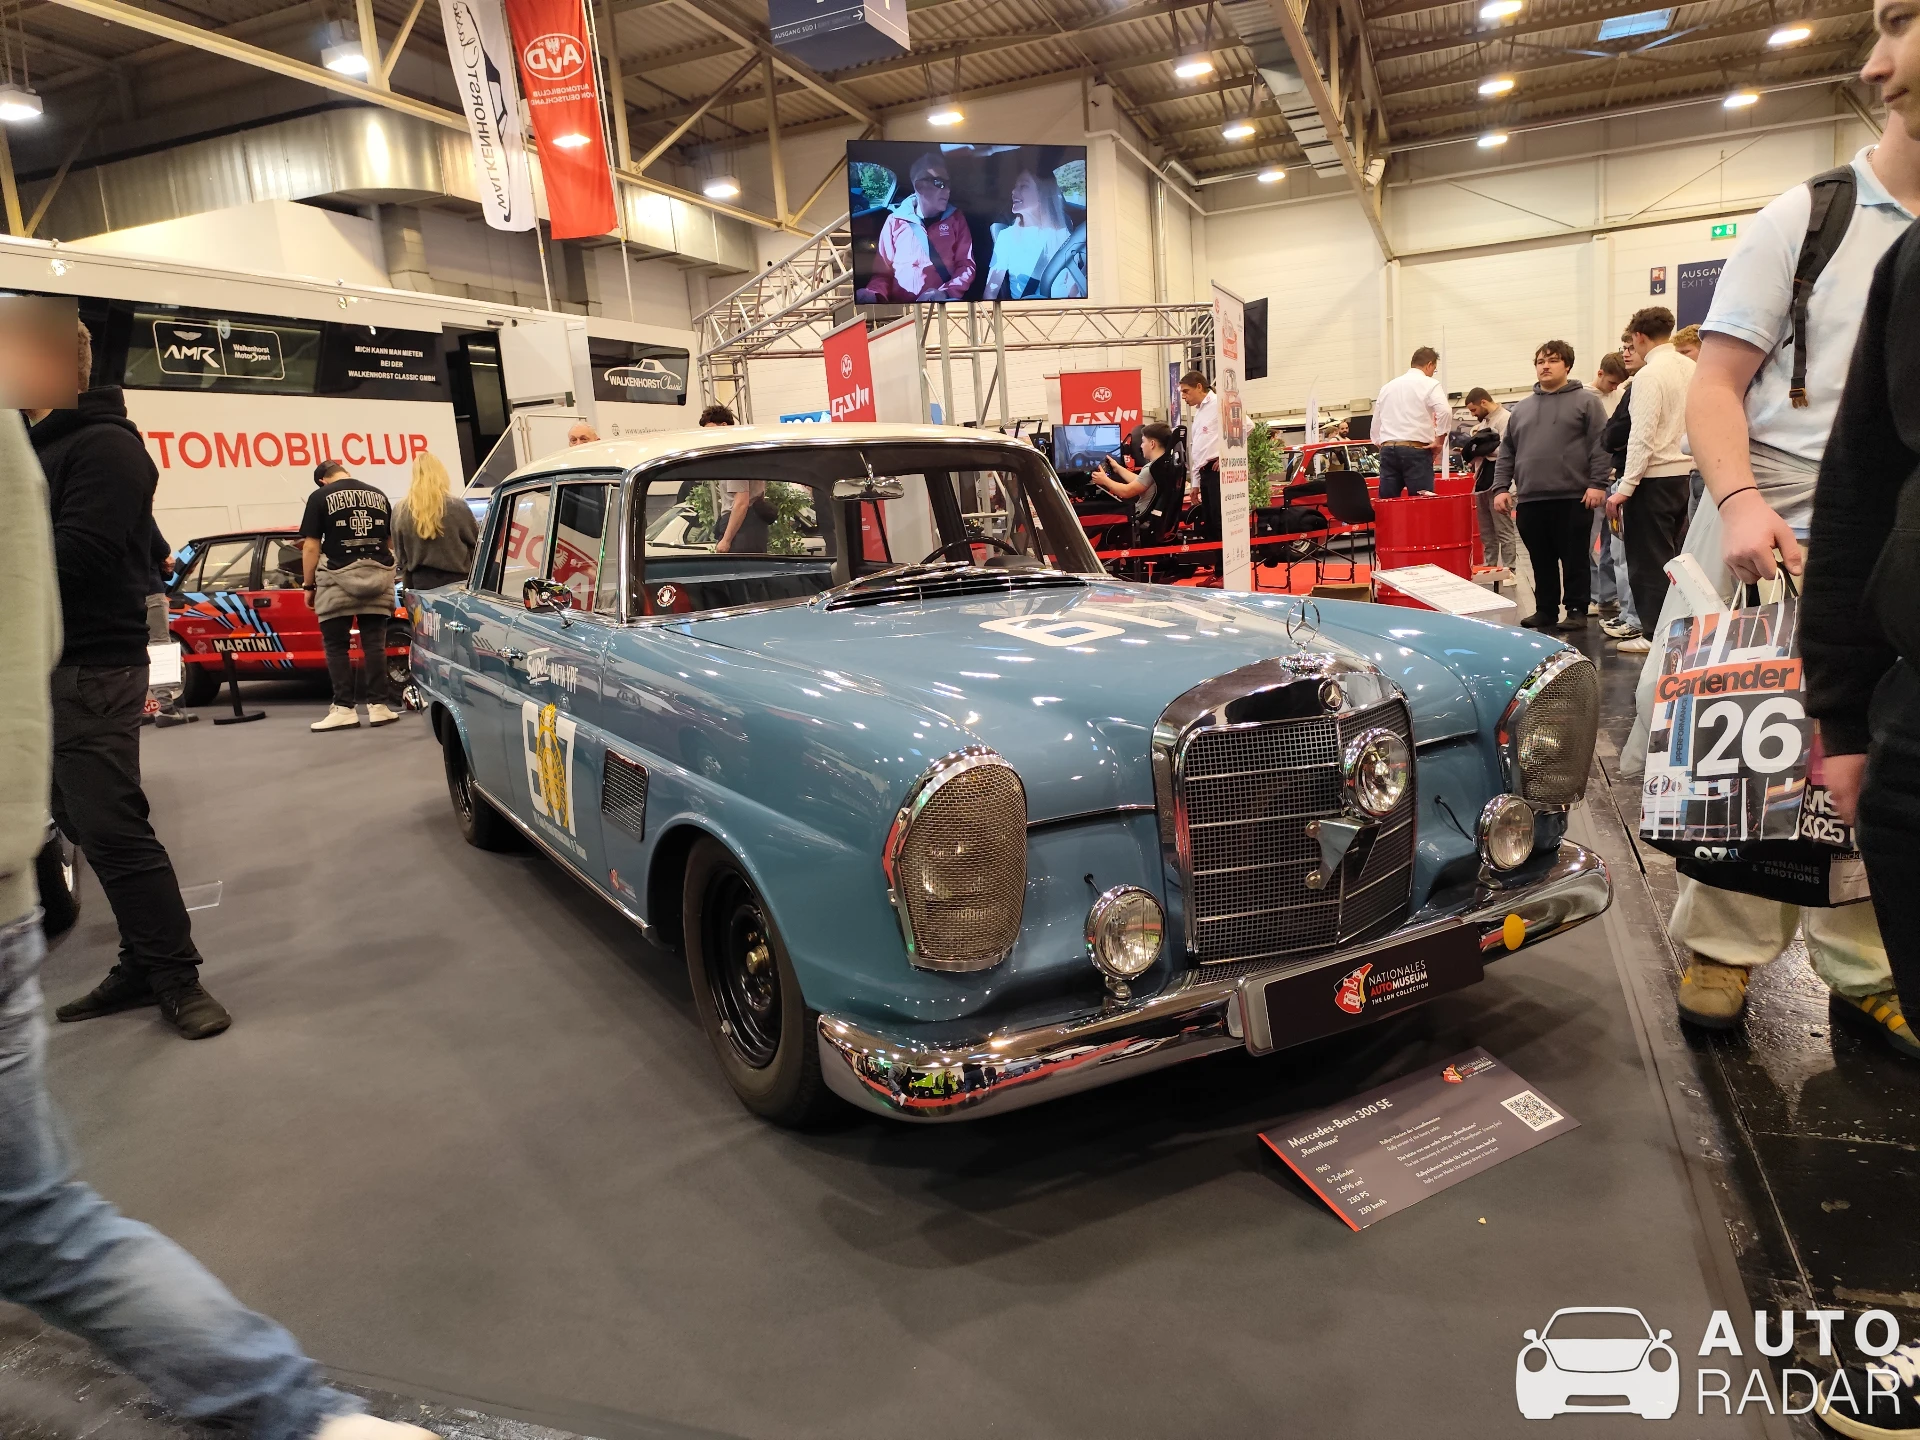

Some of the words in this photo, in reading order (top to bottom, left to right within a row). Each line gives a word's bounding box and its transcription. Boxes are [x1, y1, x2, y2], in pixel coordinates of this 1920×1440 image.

[774, 29, 800, 39] AUSGANG
[802, 24, 814, 33] SÜD
[1682, 279, 1704, 289] EXIT
[164, 344, 220, 368] AMR
[232, 343, 270, 354] Walkenhorst
[371, 347, 388, 355] KANN
[389, 348, 402, 356] MAN
[402, 349, 423, 358] MIETEN
[348, 370, 394, 379] WALKENHORST
[394, 373, 419, 381] CLASSIC
[609, 375, 660, 389] WALKENHORST
[660, 375, 682, 390] Classic
[140, 431, 429, 468] TOMOBILCLUB
[326, 490, 356, 515] NEW
[213, 638, 273, 652] MARTINI
[1676, 697, 1688, 764] JPPERFORMANCE
[1696, 696, 1806, 777] 26
[1764, 866, 1820, 885] EMOTIONS
[1369, 960, 1426, 986] NATIONALES
[1371, 970, 1428, 997] AUTOMUSEUM
[1384, 993, 1395, 1001] LOH
[1396, 982, 1429, 997] COLLECTION
[1457, 1057, 1488, 1071] NATIONALES
[1288, 1115, 1359, 1148] Mercedes-Benz
[1356, 1104, 1378, 1119] 300
[1376, 1098, 1393, 1110] SE
[1315, 1164, 1331, 1174] 1965
[1327, 1168, 1355, 1183] 6-Zylinder
[1337, 1182, 1354, 1194] 2.996
[1347, 1195, 1361, 1204] 230
[1358, 1206, 1371, 1215] 230
[1370, 1199, 1388, 1209] km/h
